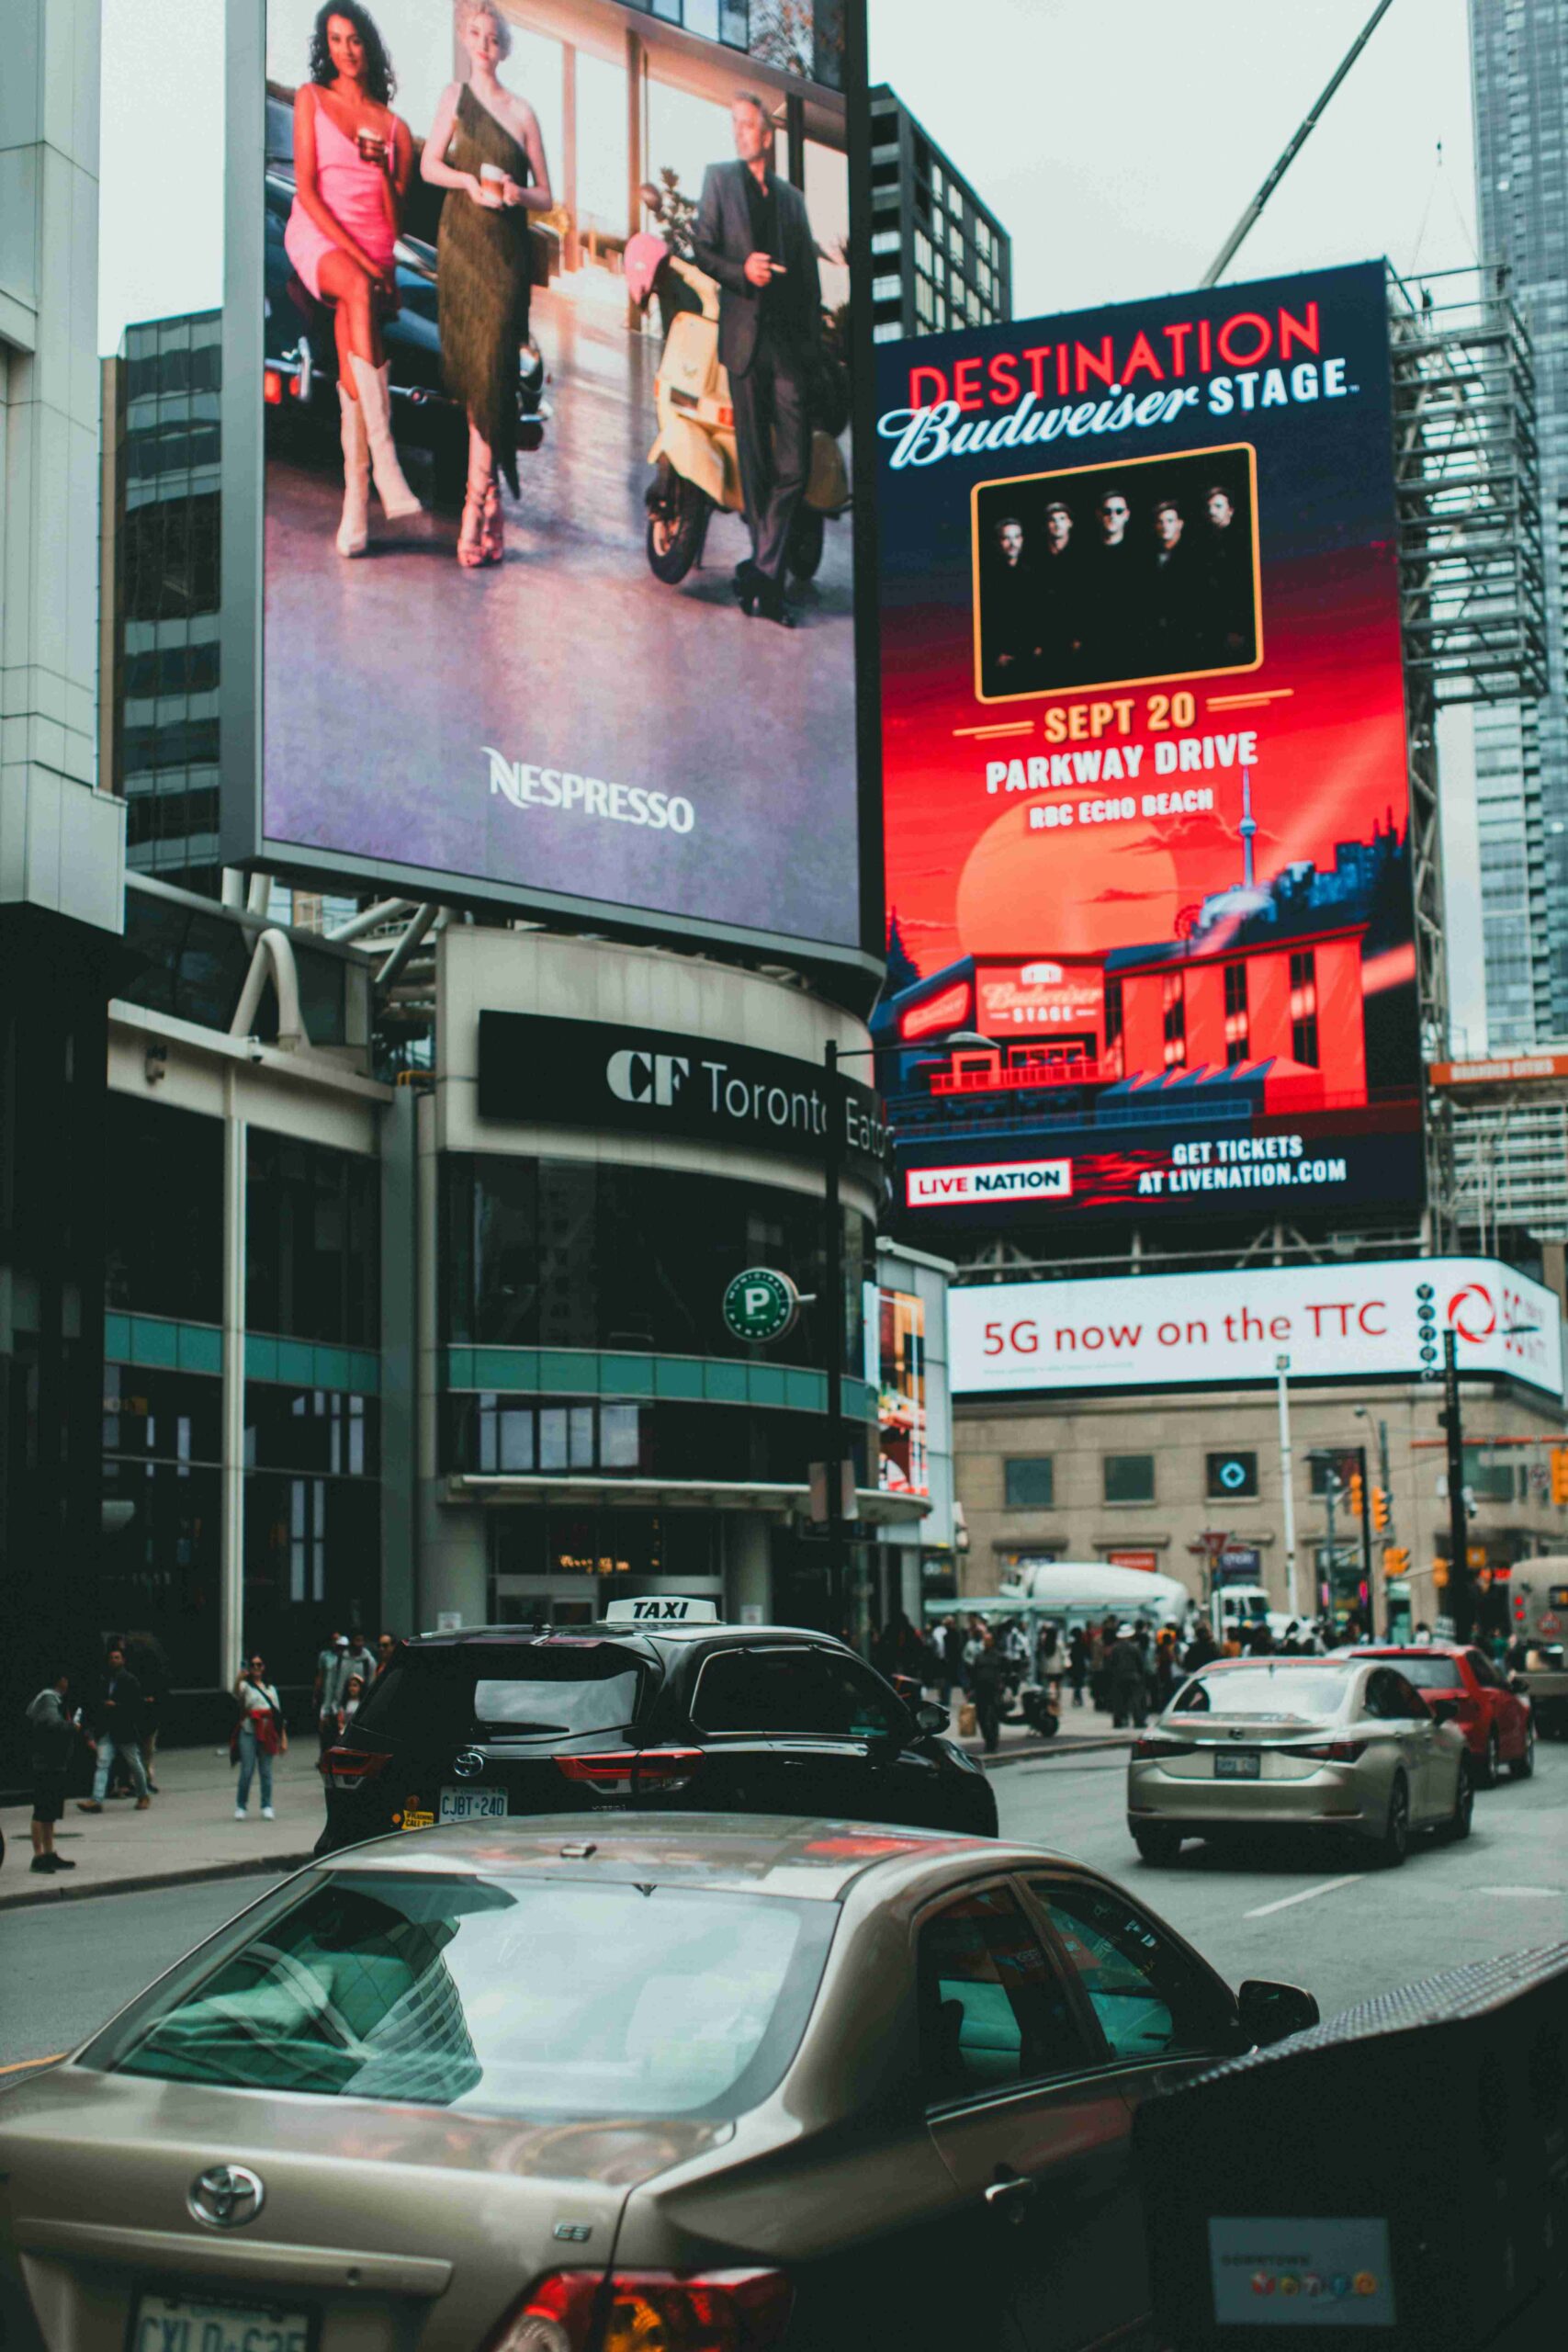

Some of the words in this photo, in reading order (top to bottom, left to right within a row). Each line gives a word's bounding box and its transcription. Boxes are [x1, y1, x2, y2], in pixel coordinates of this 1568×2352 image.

[908, 300, 1320, 417] DESTINATION
[877, 383, 1200, 470] Budweiser
[1208, 357, 1348, 415] STAGE
[1043, 698, 1135, 744] SEPT
[1147, 691, 1195, 731] 20
[986, 744, 1144, 794] PARKWAY
[1154, 731, 1258, 775] DRIVE
[480, 745, 694, 833] NESPRESSO
[1030, 803, 1073, 829] RBC
[1078, 797, 1135, 823] ECHO
[1142, 787, 1213, 817] BEACH
[1013, 1006, 1073, 1023] STAGE
[606, 1049, 690, 1106] CF
[1172, 1142, 1212, 1166] GET
[1216, 1135, 1303, 1162] TICKETS
[919, 1176, 968, 1195] LIVE
[975, 1170, 1060, 1193] NATION
[1138, 1170, 1164, 1193] AT
[1168, 1159, 1348, 1193] LIVENATION.COM
[745, 1287, 770, 1315] P
[983, 1319, 1039, 1355] 5G
[1055, 1323, 1142, 1351] now
[1156, 1321, 1208, 1346] on
[1223, 1306, 1292, 1342] the
[1304, 1301, 1387, 1336] TTC
[633, 1602, 689, 1619] TAXI
[442, 1795, 474, 1815] CJBT
[480, 1796, 504, 1816] 240
